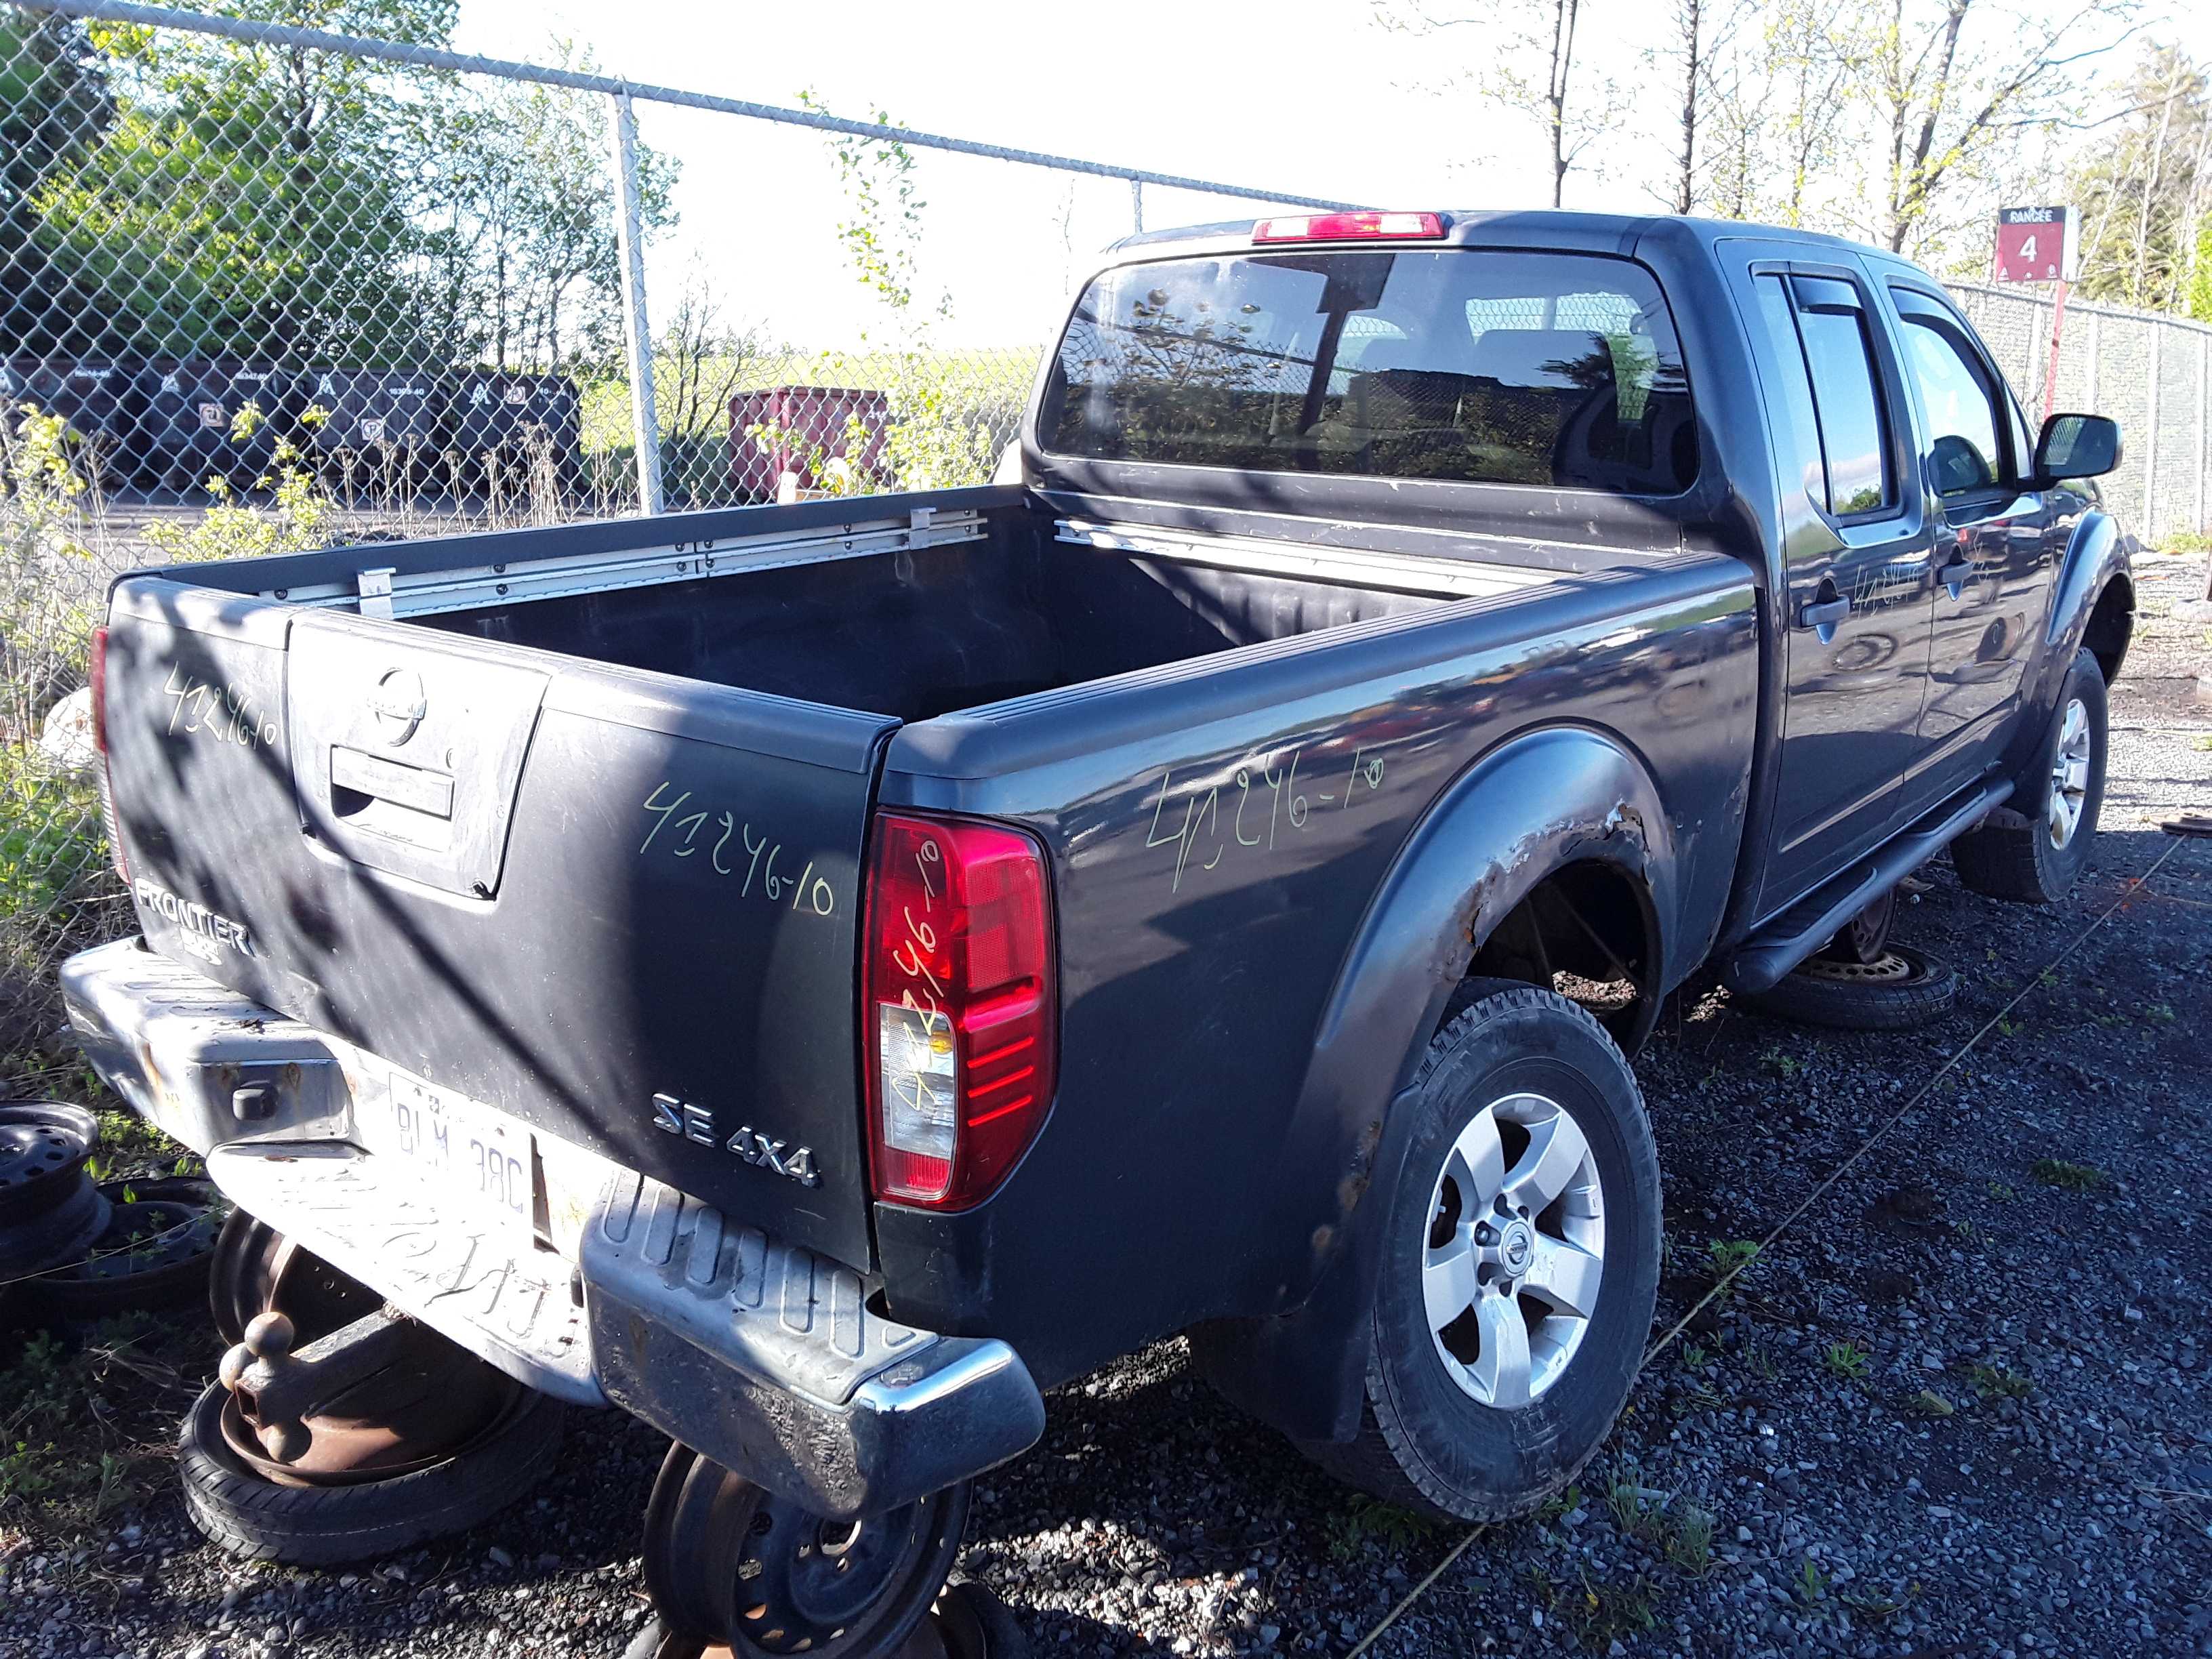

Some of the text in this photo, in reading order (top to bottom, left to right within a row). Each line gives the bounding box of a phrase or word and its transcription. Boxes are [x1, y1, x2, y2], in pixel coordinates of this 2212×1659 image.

[2019, 234, 2037, 263] 4
[134, 877, 258, 958] FRONTIER
[651, 1091, 716, 1148] SE
